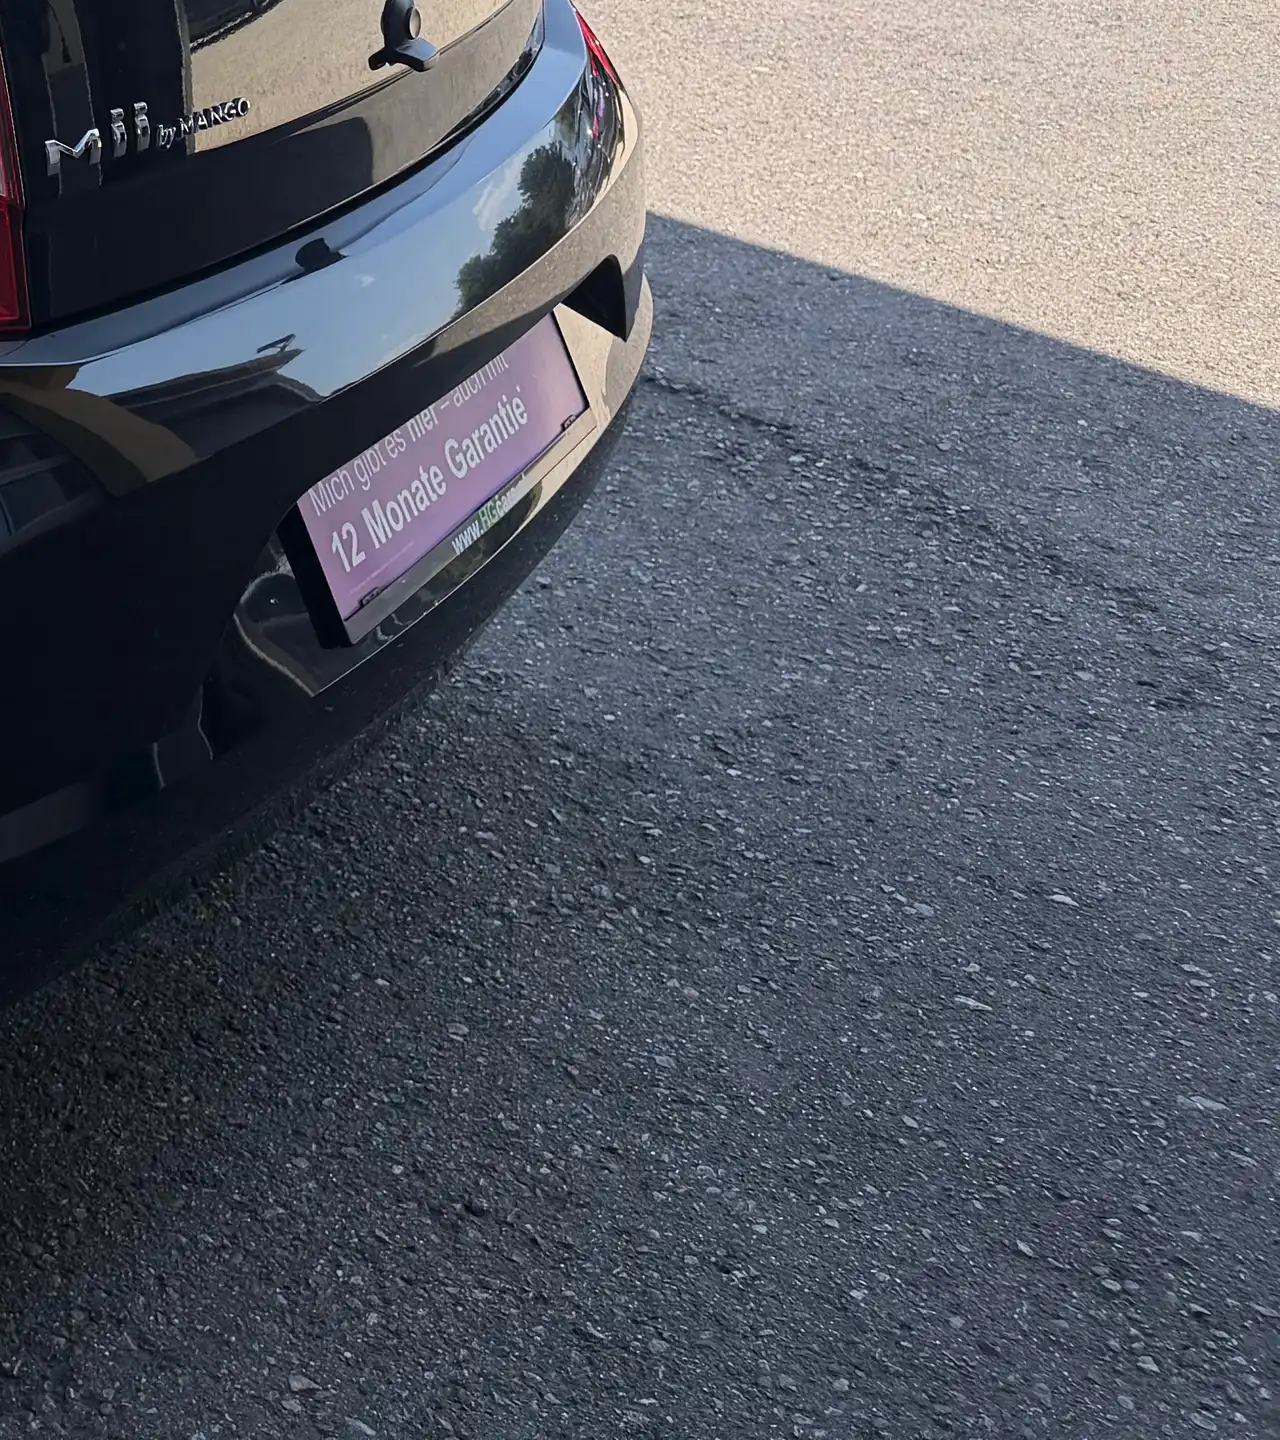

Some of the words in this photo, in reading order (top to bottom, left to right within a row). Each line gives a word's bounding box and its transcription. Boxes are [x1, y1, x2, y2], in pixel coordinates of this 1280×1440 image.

[44, 101, 151, 176] Mii
[156, 123, 177, 149] by
[178, 96, 252, 136] MANGO
[307, 468, 355, 517] Mich
[383, 428, 407, 458] es
[330, 521, 367, 574] 12
[360, 461, 448, 550] Monate
